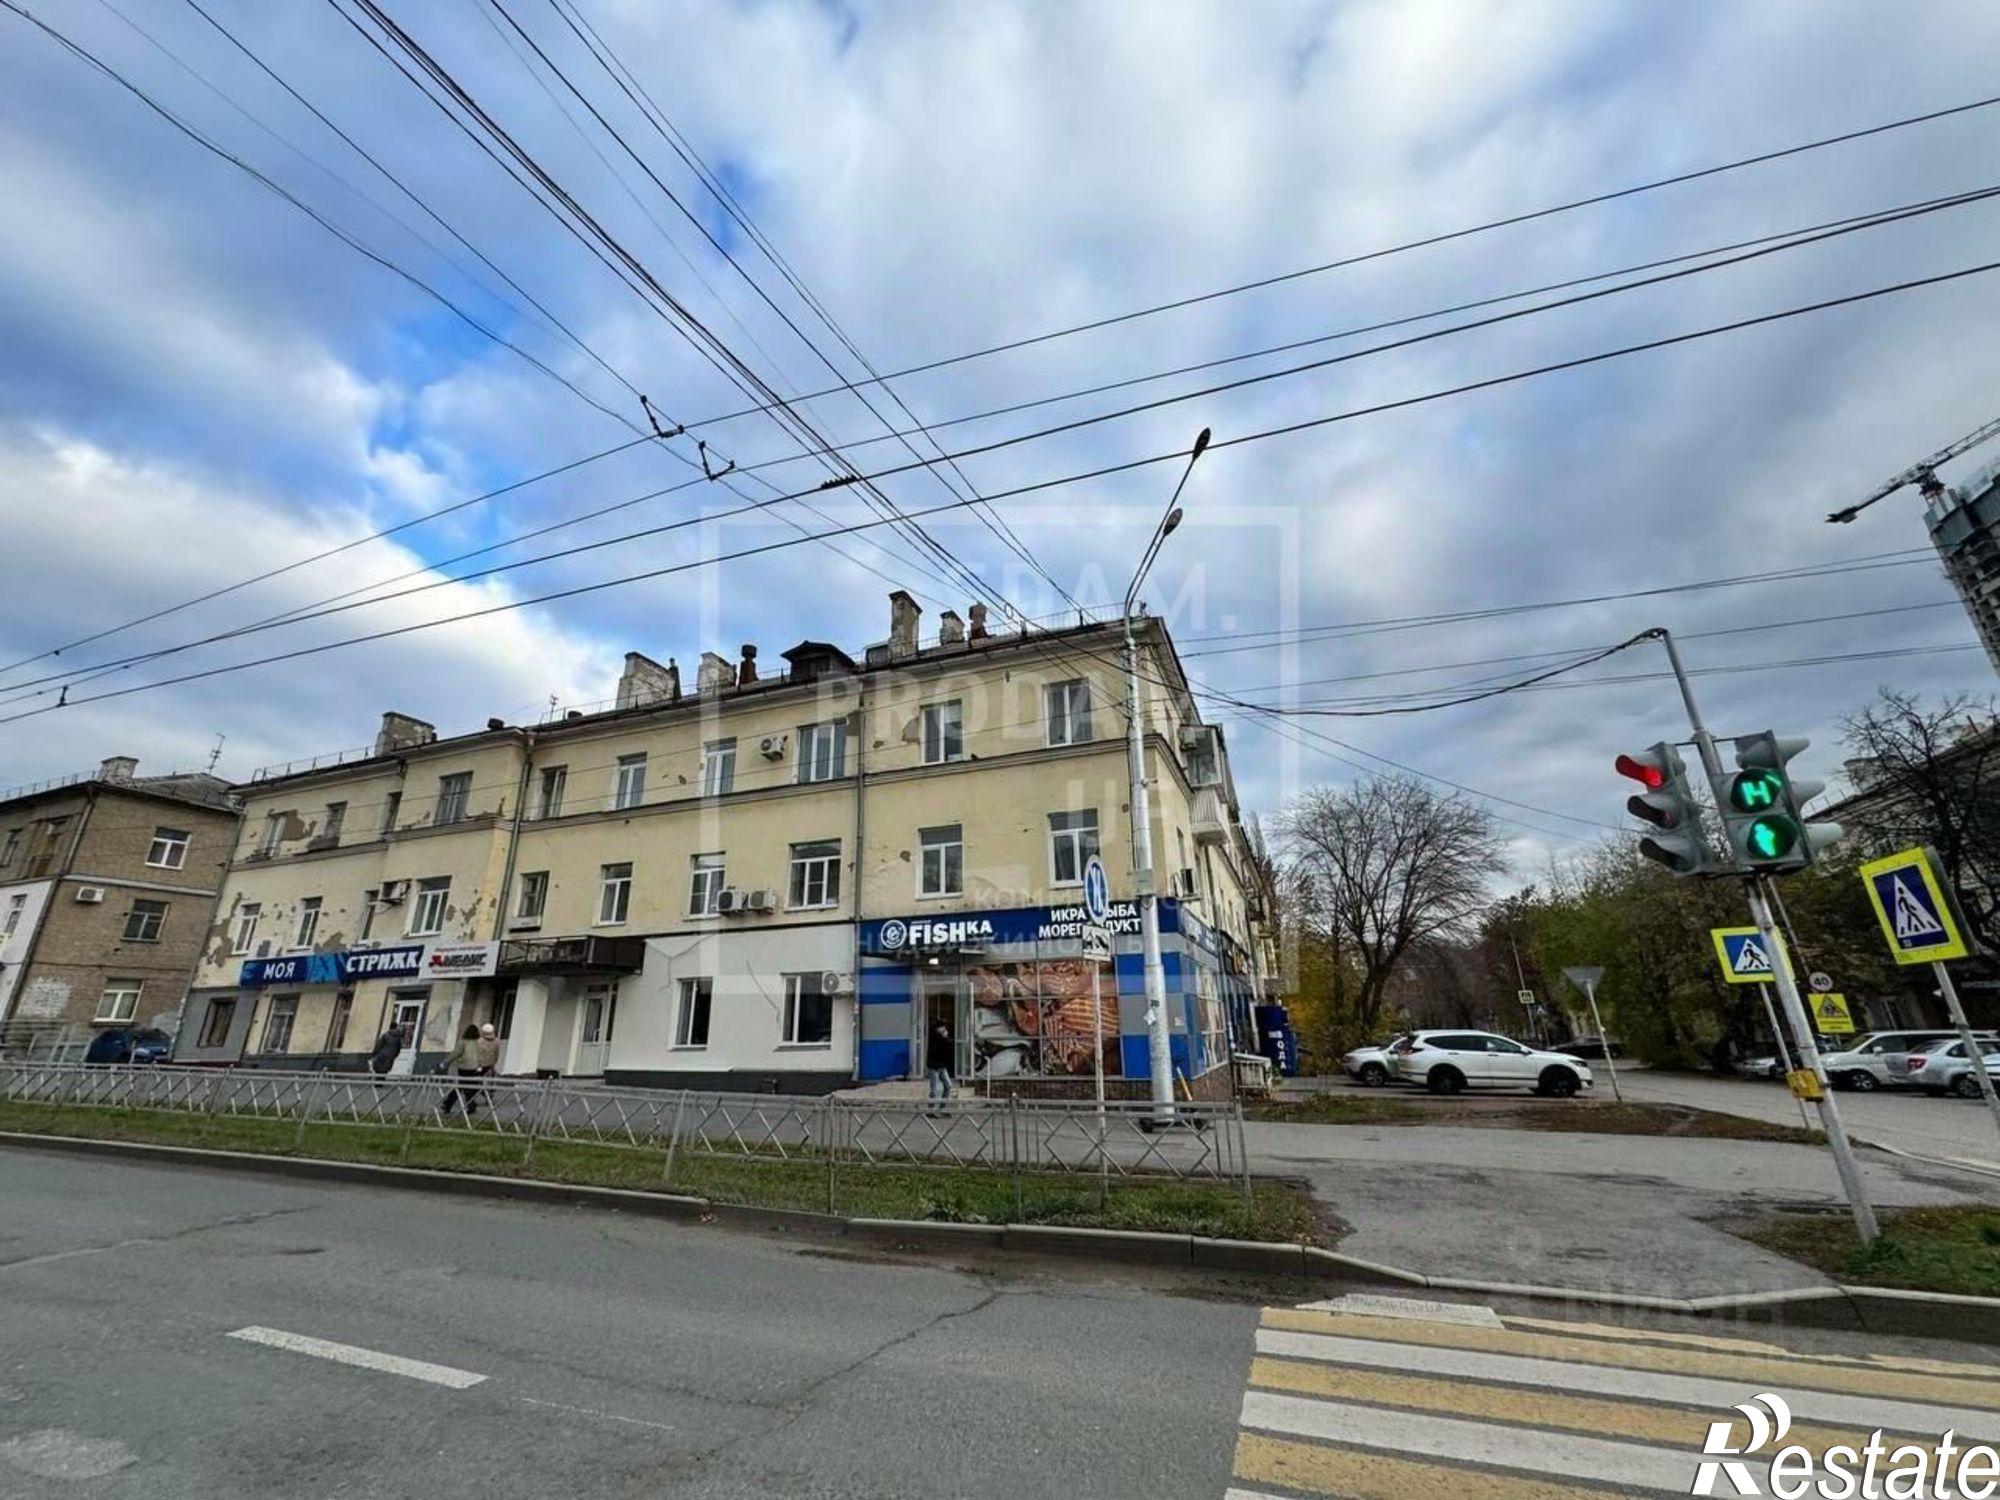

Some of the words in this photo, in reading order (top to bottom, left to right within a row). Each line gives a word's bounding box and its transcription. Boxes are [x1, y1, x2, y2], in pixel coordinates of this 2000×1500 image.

[1051, 907, 1088, 922] ИКРА
[1105, 904, 1138, 918] ЫБА
[263, 961, 296, 979] МОЯ
